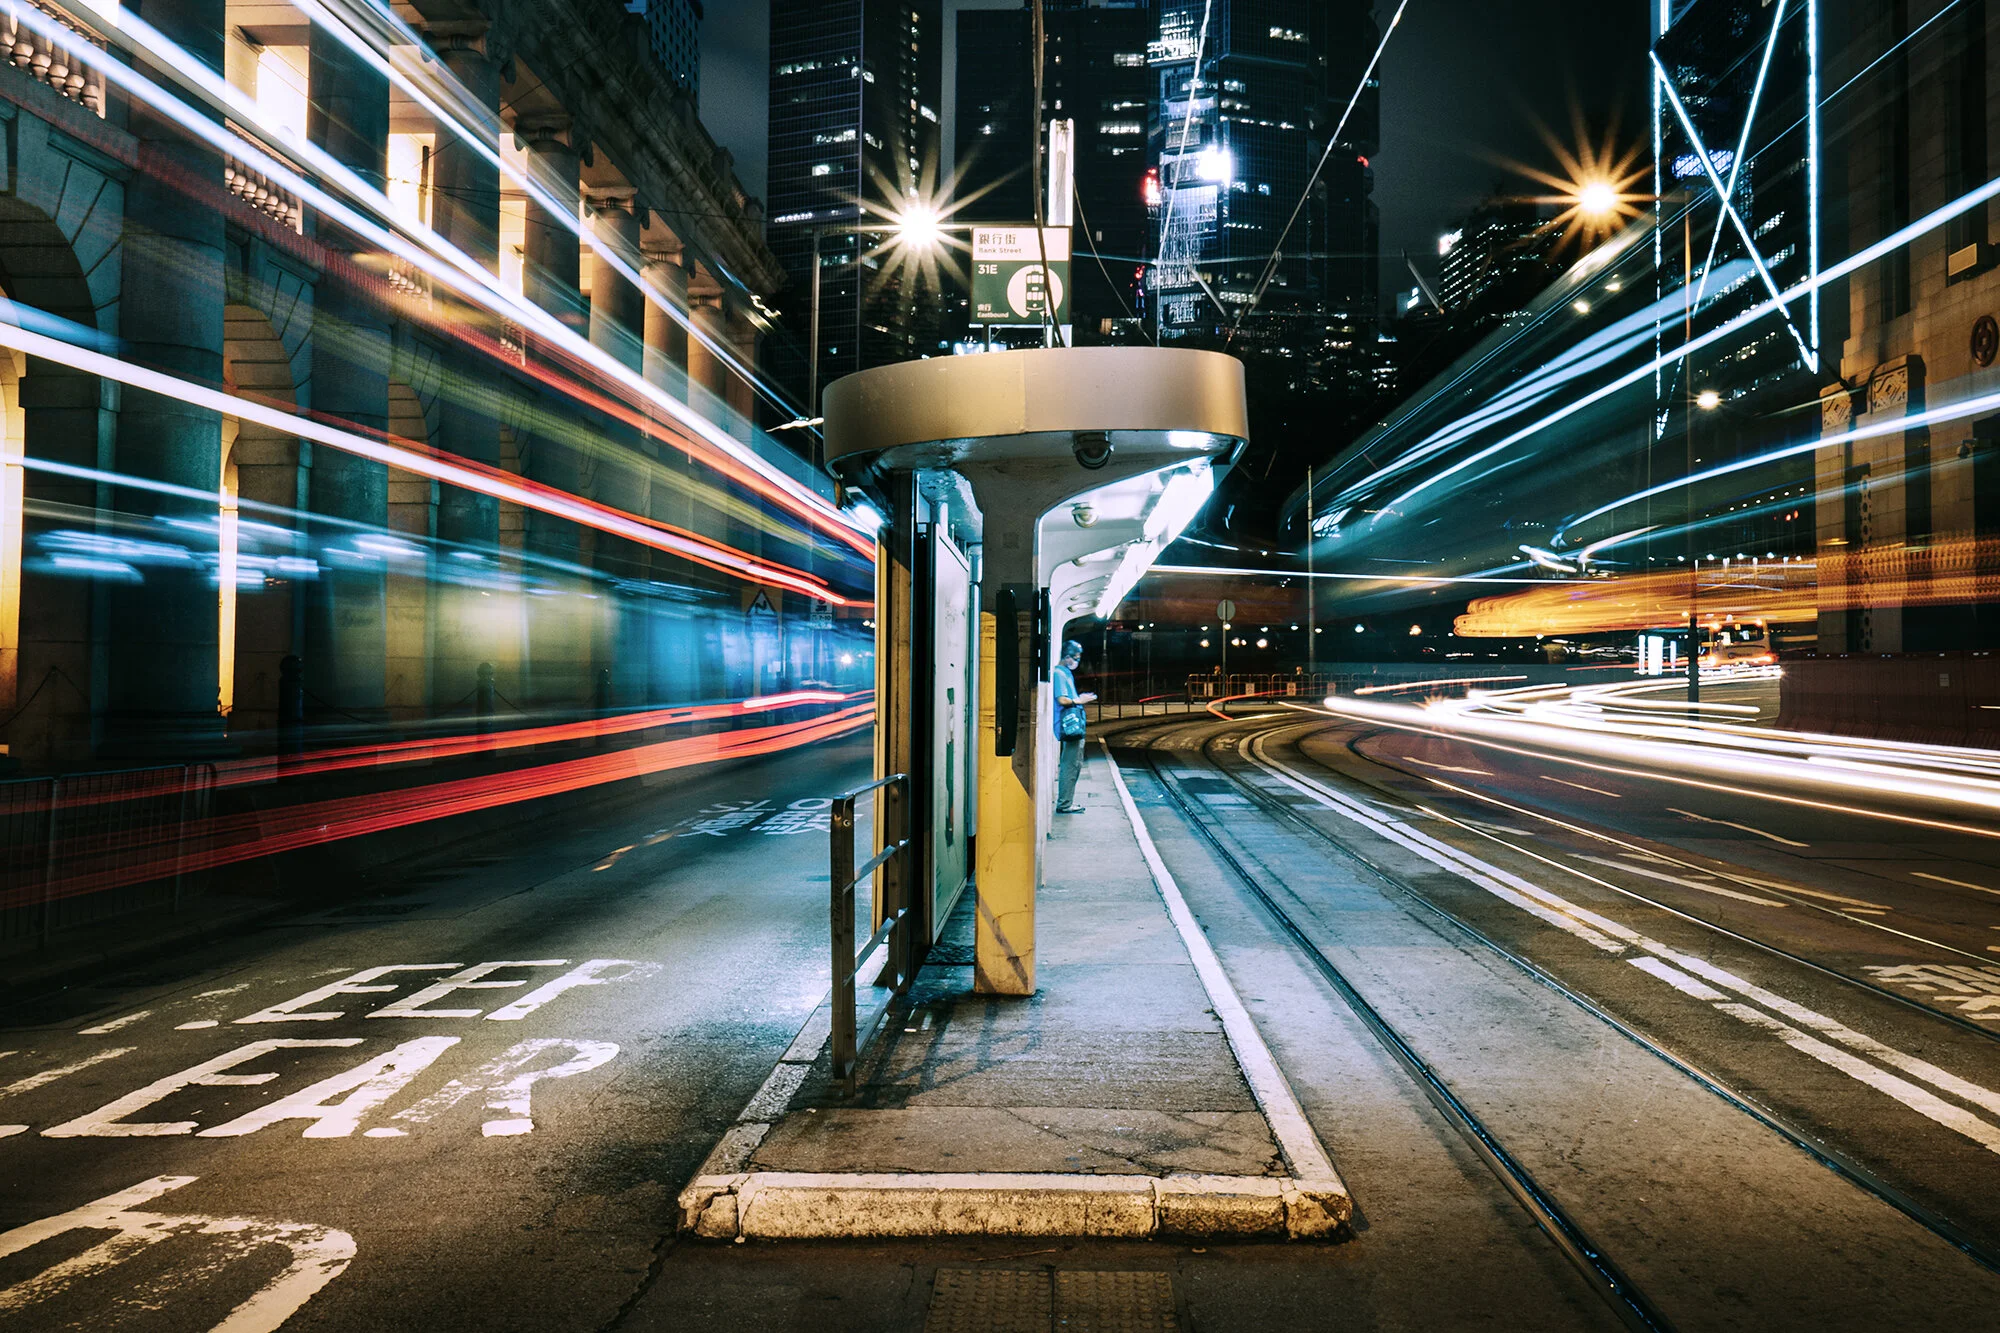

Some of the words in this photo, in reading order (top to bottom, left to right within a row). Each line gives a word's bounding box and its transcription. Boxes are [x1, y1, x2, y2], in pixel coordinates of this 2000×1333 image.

[978, 233, 1016, 245] 銀行街
[978, 264, 998, 275] 31E
